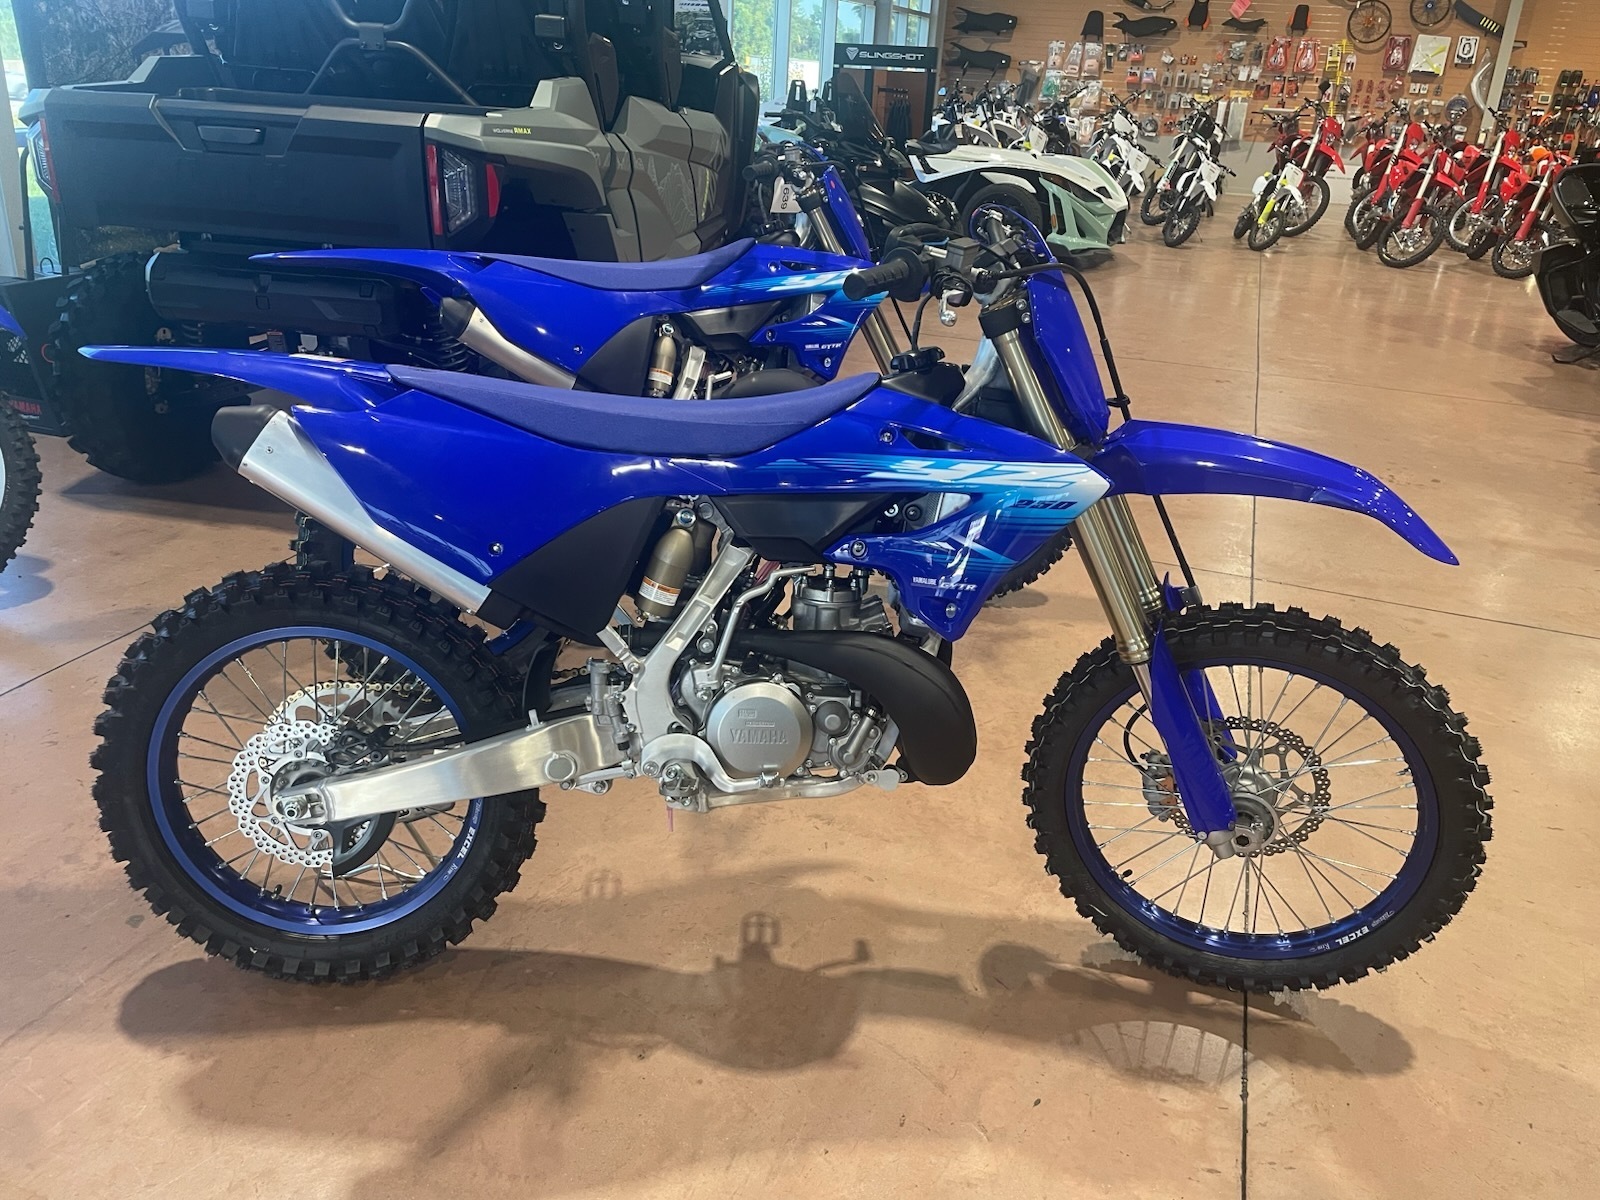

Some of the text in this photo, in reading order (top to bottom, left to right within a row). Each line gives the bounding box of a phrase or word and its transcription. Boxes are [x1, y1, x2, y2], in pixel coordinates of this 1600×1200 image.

[859, 51, 924, 60] SLINGSHOT
[780, 187, 790, 209] 639
[861, 460, 1091, 488] YZ
[1009, 499, 1078, 510] 250
[940, 582, 978, 592] GYTR
[729, 728, 789, 745] YAMAHA
[457, 826, 476, 859] EXCEL
[1335, 926, 1370, 945] EXCEL
